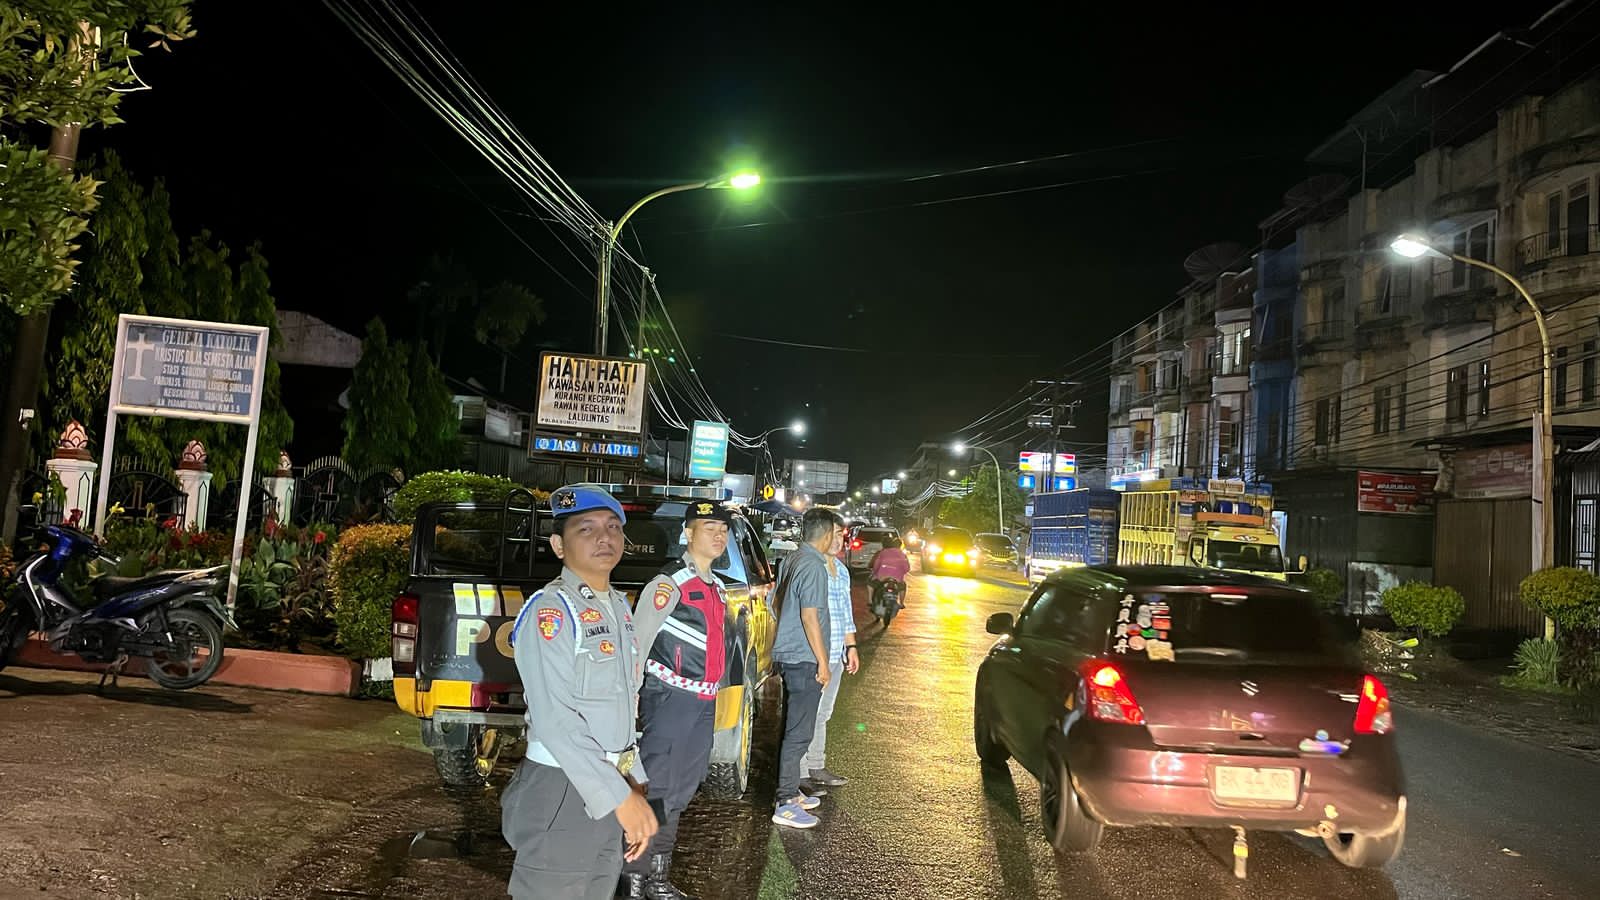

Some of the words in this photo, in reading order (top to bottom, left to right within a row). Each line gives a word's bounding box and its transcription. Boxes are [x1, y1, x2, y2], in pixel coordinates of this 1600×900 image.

[162, 329, 203, 347] GEREJA
[206, 334, 250, 352] KATOLIK
[155, 348, 185, 363] KRISTUS
[203, 351, 234, 368] SEMESTA
[548, 378, 595, 392] KAWASAN
[598, 382, 630, 396] RAMAI
[554, 391, 586, 401] KURANGI
[587, 394, 626, 405] KECEPATAN
[553, 401, 578, 411] RAWAN
[580, 403, 626, 415] KECELAKAAN
[552, 438, 577, 452] JASA
[581, 442, 633, 456] RAHARJA
